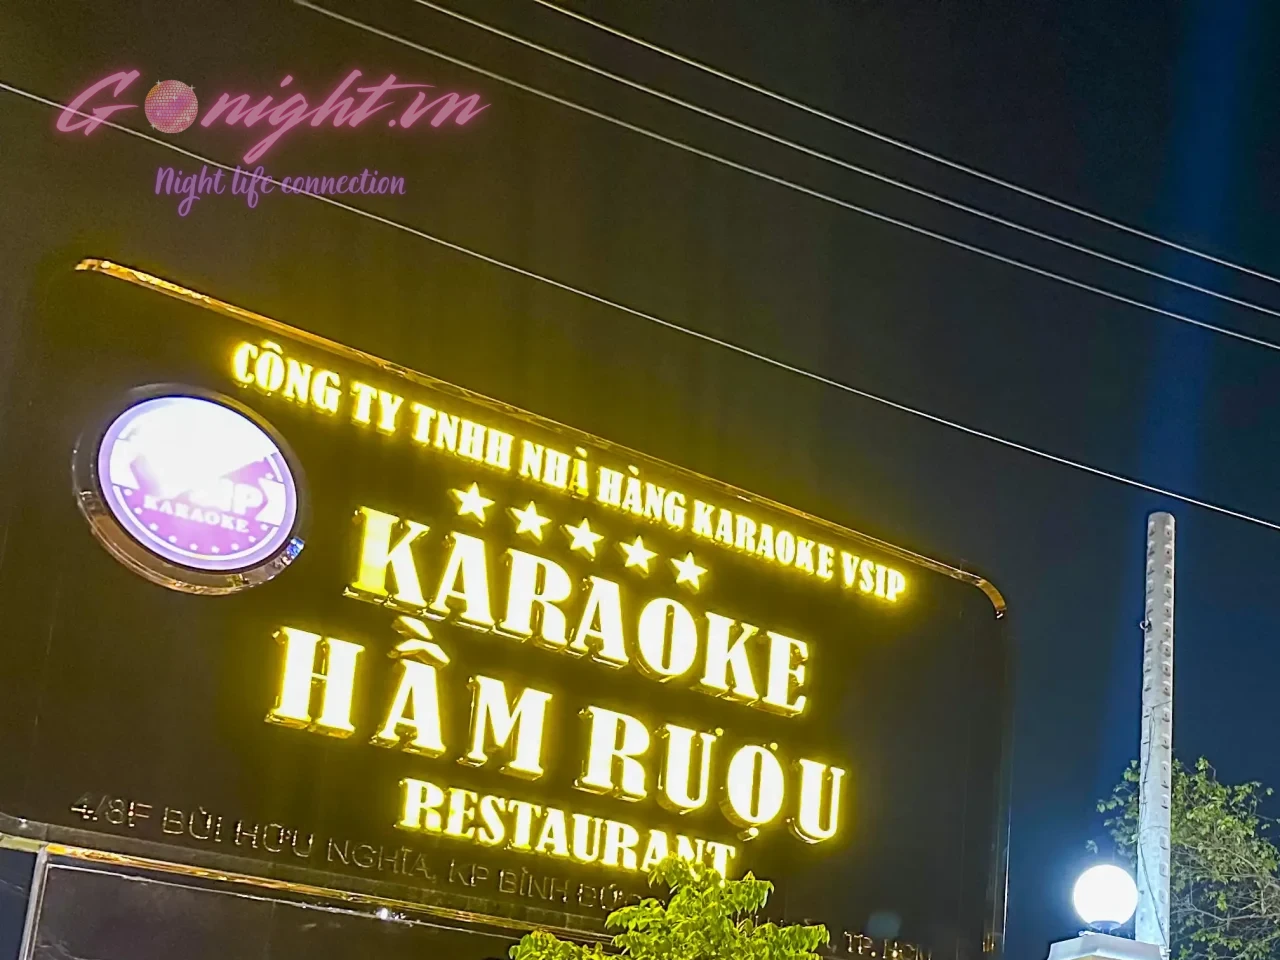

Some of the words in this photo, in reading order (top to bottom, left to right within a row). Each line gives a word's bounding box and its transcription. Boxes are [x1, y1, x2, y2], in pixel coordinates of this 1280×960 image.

[143, 494, 249, 533] KARAOKE
[232, 339, 342, 415] CÔNG
[350, 380, 404, 434] TY
[409, 401, 516, 471] TNHH
[518, 445, 589, 498] NHÀ
[596, 464, 688, 531] HÀNG
[691, 499, 836, 581] KARAOKE
[839, 550, 907, 602] VSIP
[344, 505, 811, 717] KARAOKE
[268, 616, 553, 780] HẦM
[396, 777, 736, 888] RESTAURANT
[448, 858, 490, 887] KP
